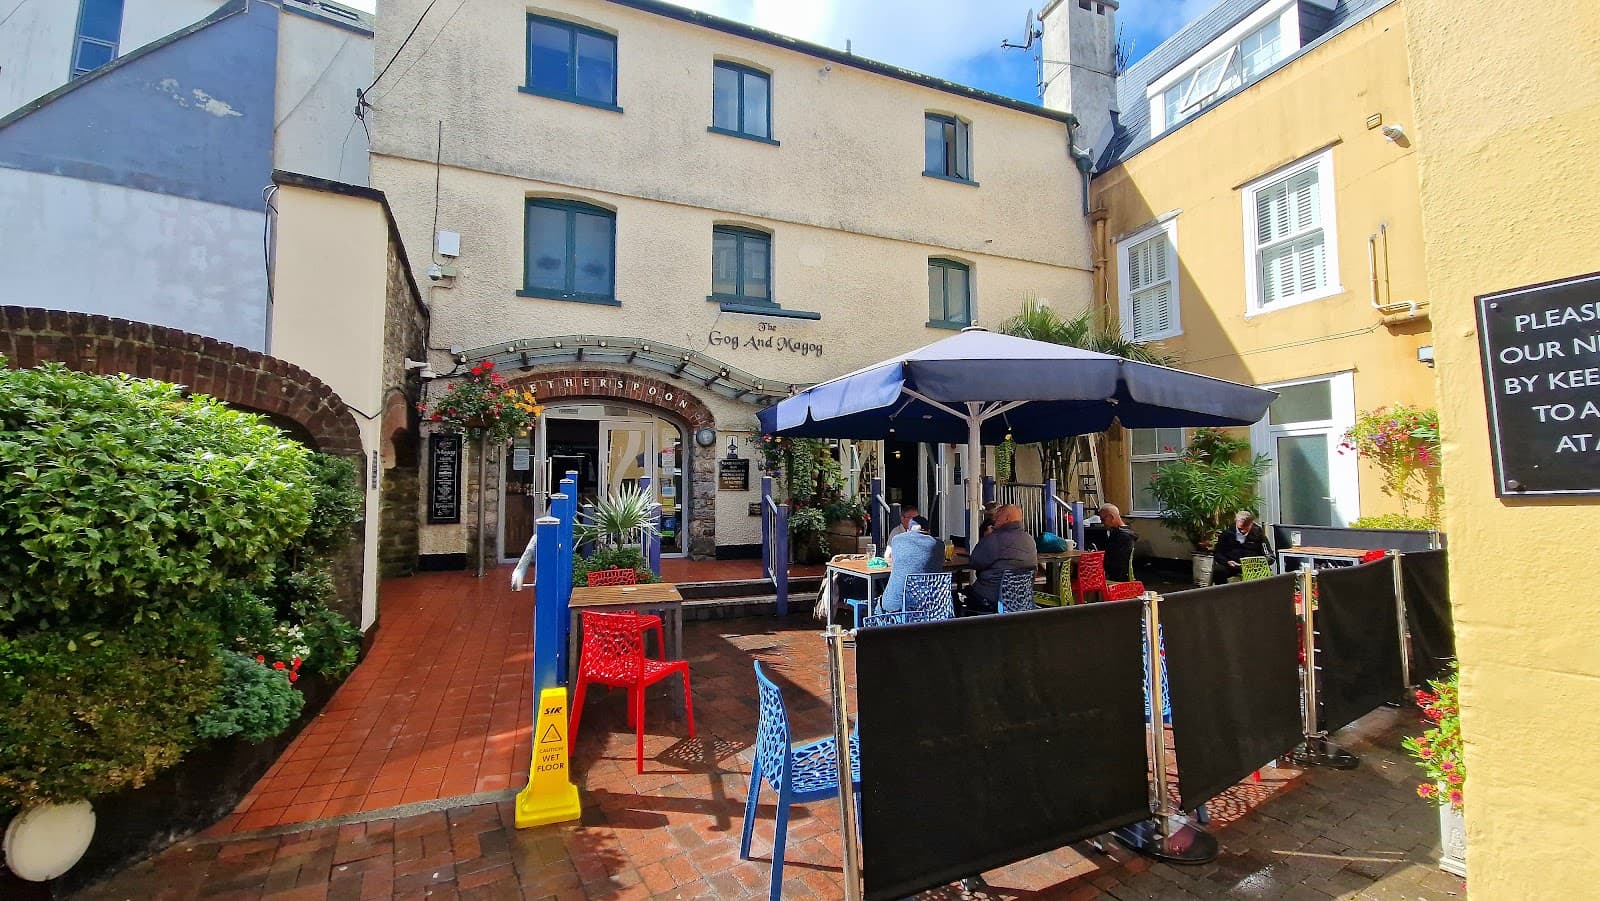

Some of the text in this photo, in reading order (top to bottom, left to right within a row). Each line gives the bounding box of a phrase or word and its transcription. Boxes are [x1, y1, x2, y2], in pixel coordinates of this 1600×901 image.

[758, 322, 777, 331] The
[708, 331, 823, 358] Gog And Magog
[1500, 335, 1600, 364] OUR N
[529, 378, 687, 409] ETHERSPOON
[1504, 374, 1540, 395] BY
[1531, 403, 1575, 423] TO
[1554, 433, 1593, 453] AT
[536, 762, 565, 773] FLOOR
[542, 753, 561, 762] WET
